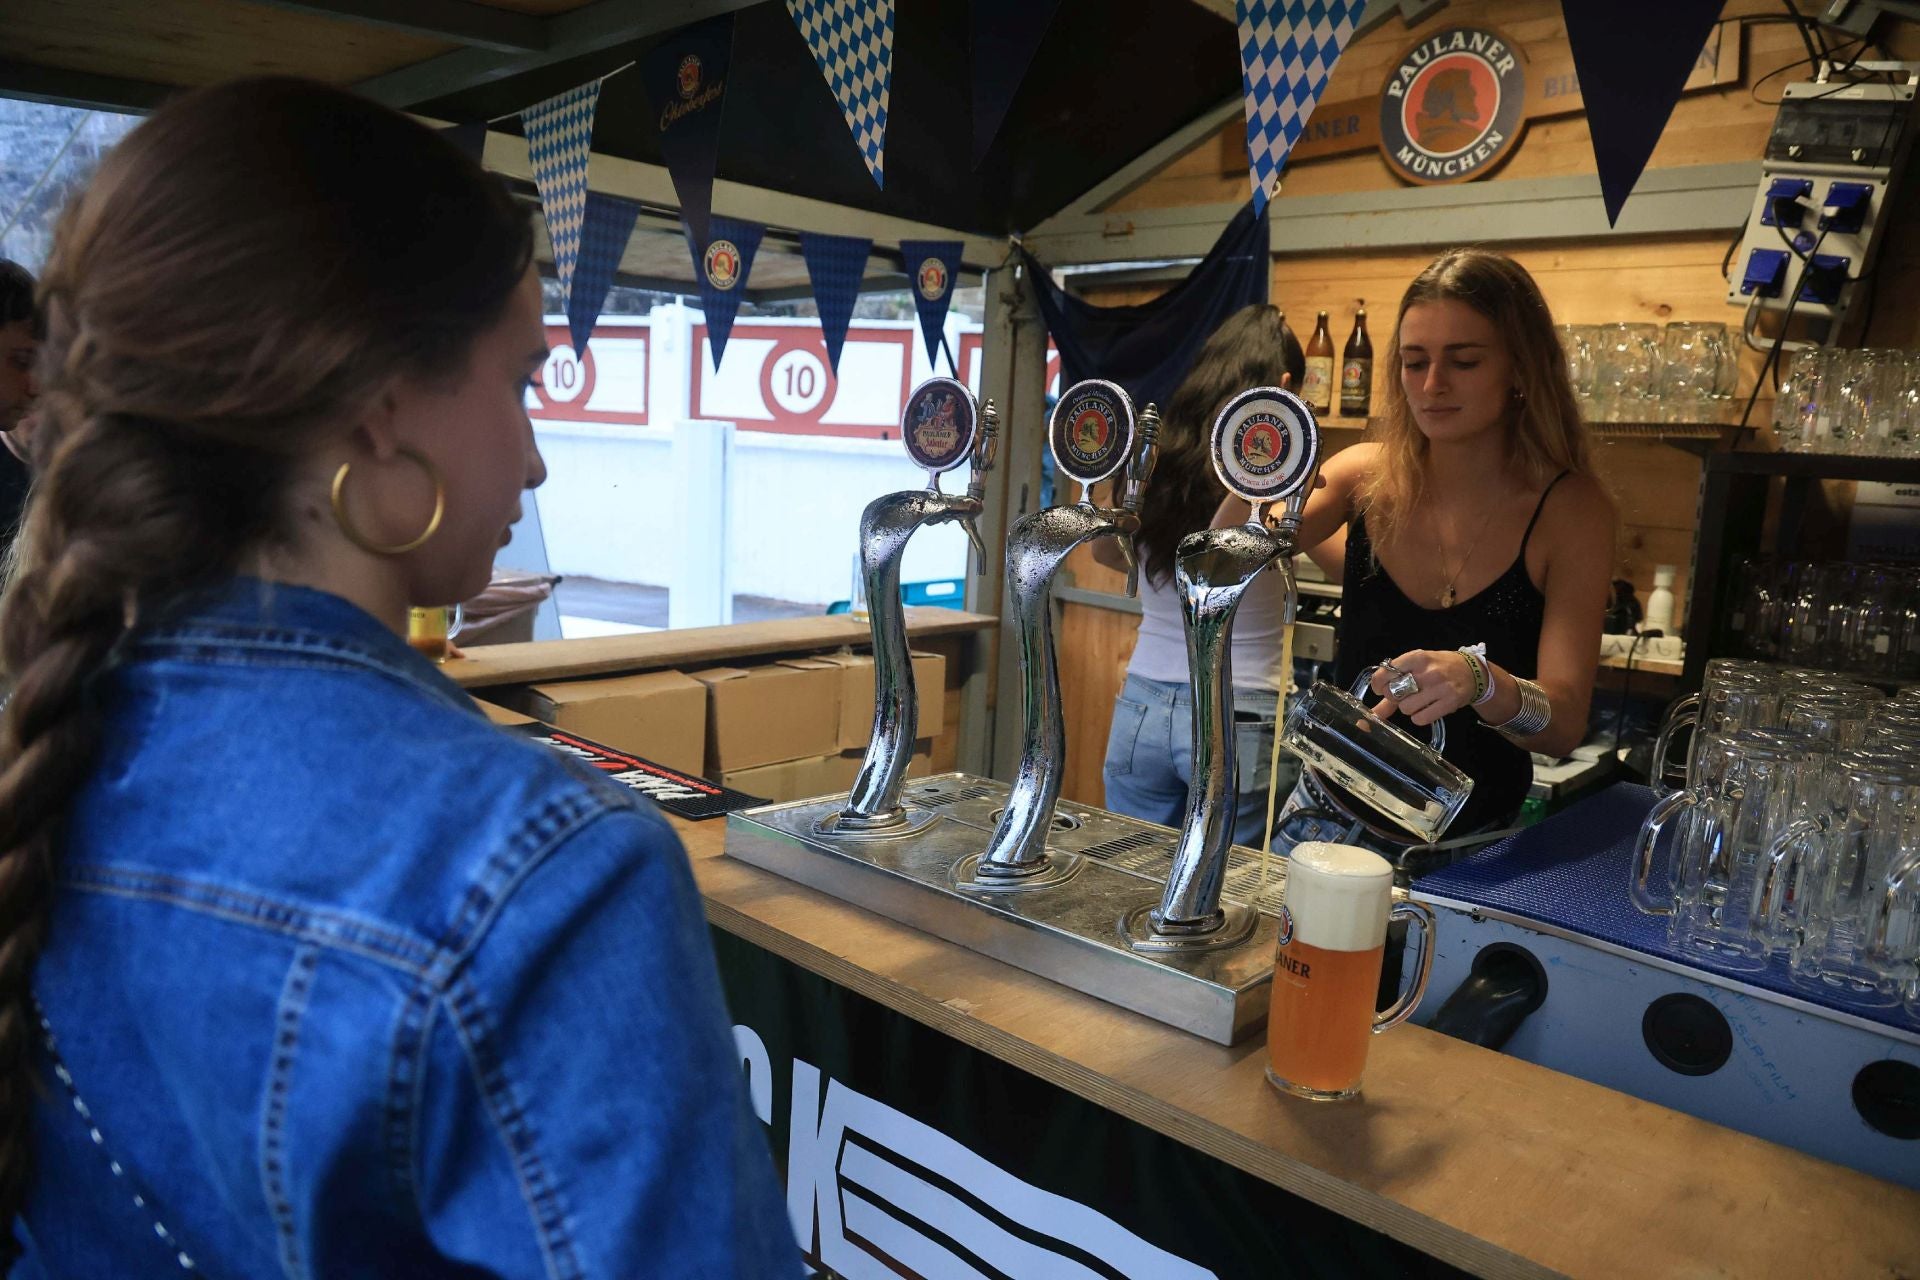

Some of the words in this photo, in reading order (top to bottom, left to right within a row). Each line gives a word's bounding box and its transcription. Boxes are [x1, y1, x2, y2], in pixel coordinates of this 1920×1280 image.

[1388, 31, 1516, 98] PAULANER
[1397, 130, 1504, 176] MÜNCHEN
[551, 359, 576, 389] 10
[785, 364, 815, 399] 10
[1069, 402, 1113, 424] PAULANER
[1238, 414, 1289, 437] PAULANER
